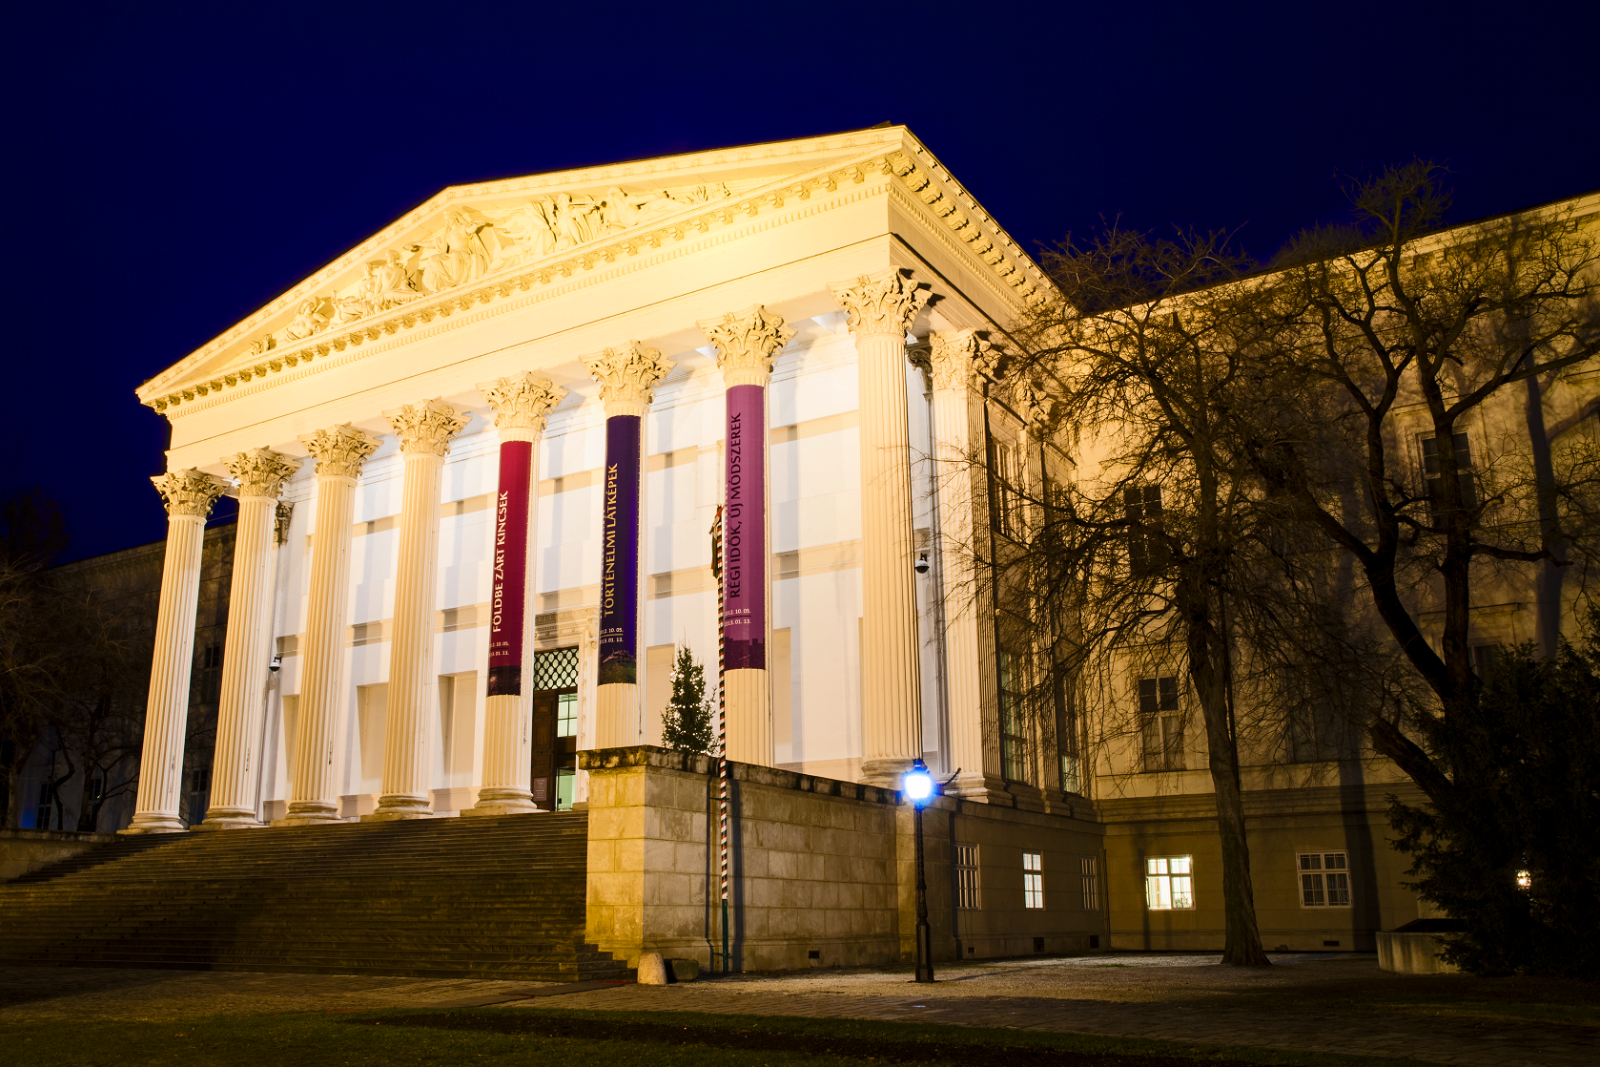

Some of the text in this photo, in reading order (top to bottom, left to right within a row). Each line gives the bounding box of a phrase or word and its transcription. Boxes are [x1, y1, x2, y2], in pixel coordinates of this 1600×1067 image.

[728, 412, 741, 500] MÓDSZEREK
[496, 490, 509, 546] KINCSEK
[605, 462, 618, 528] LÁTKÉPEK
[728, 502, 744, 518] ÚJ
[494, 548, 505, 581] ZÁRT
[727, 521, 743, 563] IDŐK,
[603, 530, 616, 618] TÖRTÉNELMI
[727, 565, 741, 599] RÉGI
[492, 582, 504, 633] FÖLDBE
